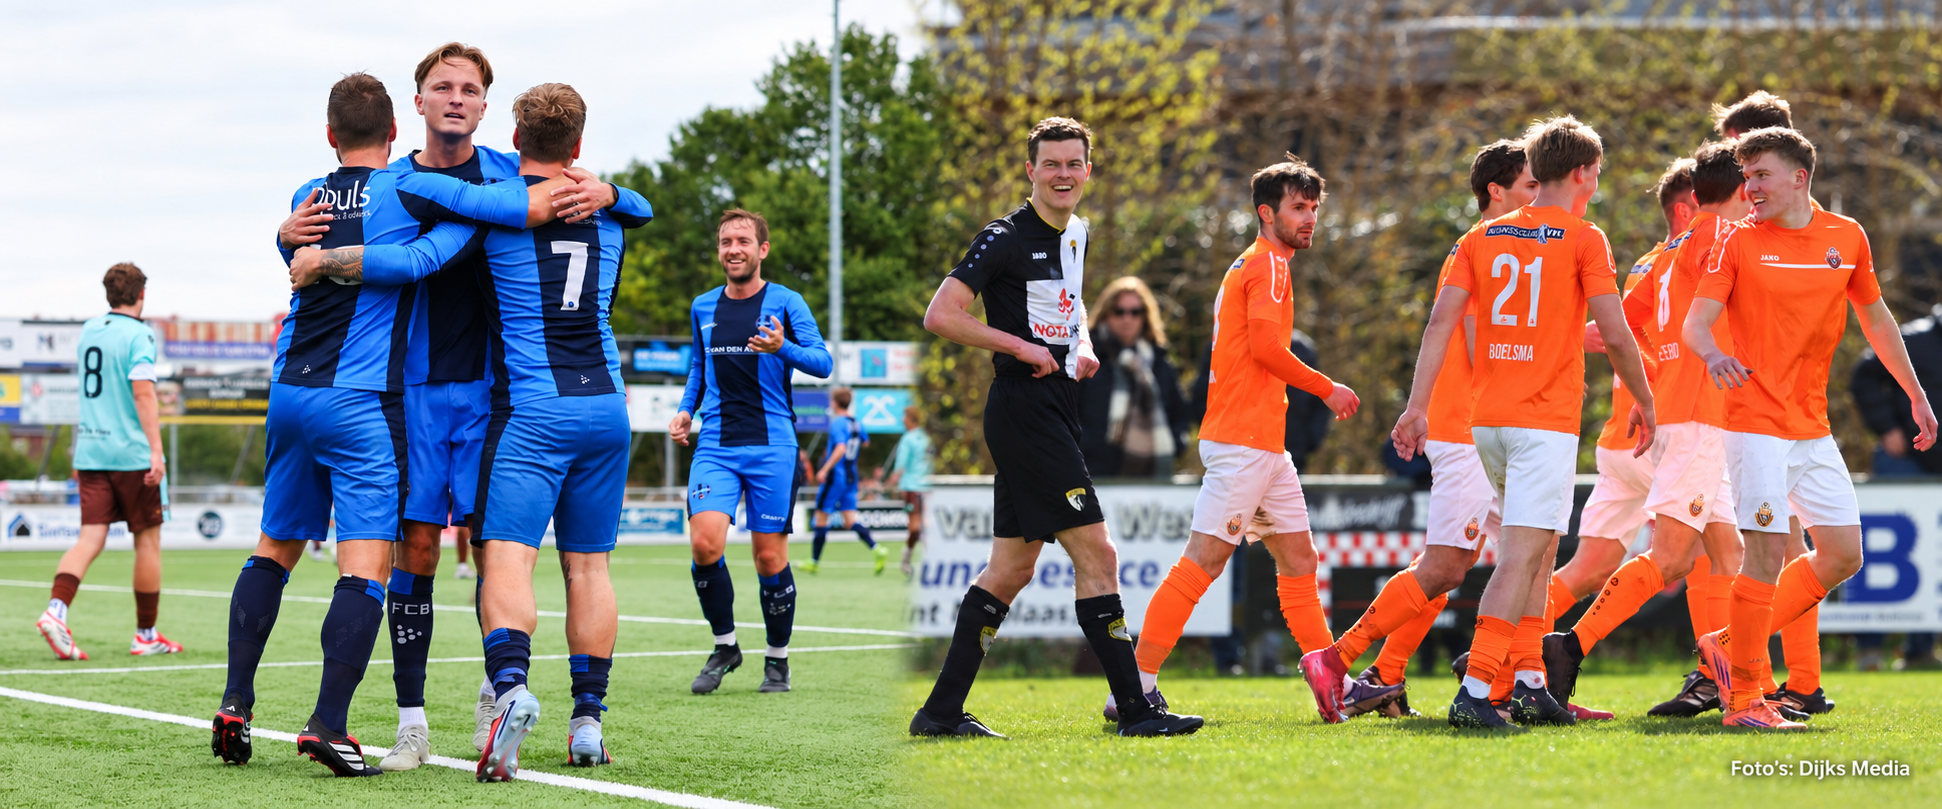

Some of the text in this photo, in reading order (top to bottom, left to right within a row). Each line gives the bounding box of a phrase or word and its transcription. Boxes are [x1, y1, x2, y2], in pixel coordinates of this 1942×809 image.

[550, 241, 589, 311] 7
[1491, 252, 1543, 327] 21
[84, 346, 103, 399] 8
[1489, 343, 1534, 362] BOELSMA
[392, 602, 429, 615] FCB
